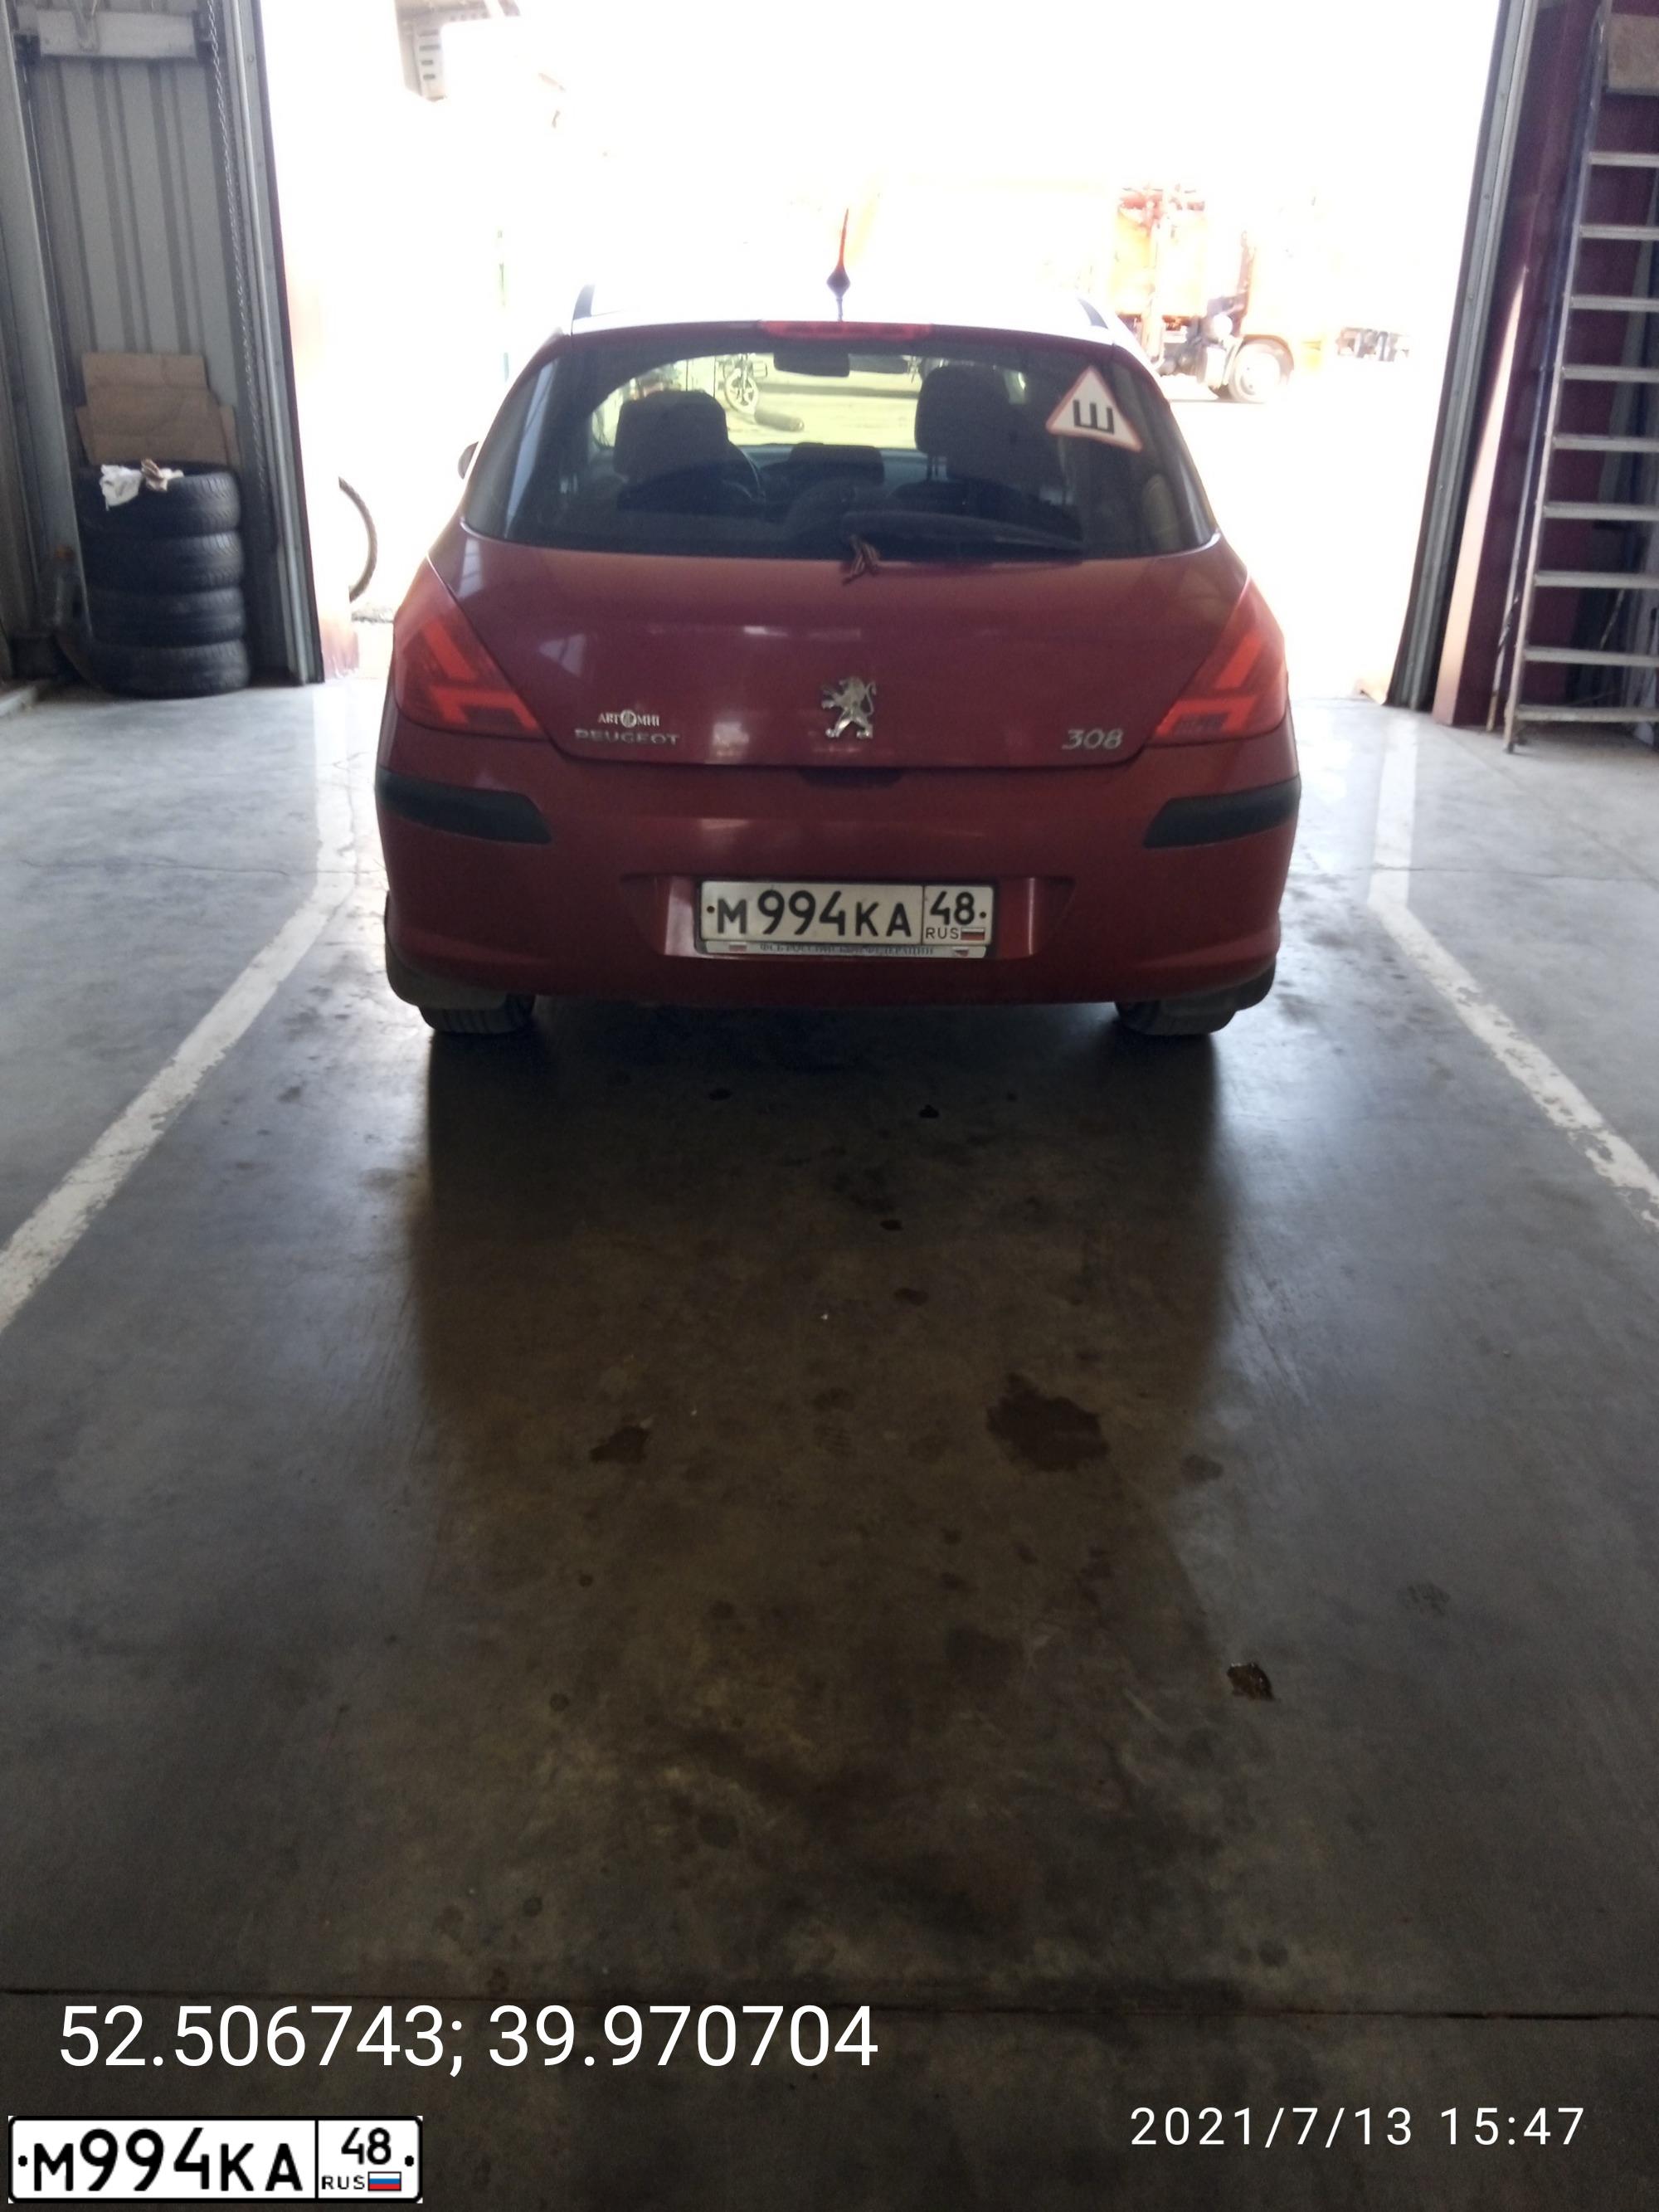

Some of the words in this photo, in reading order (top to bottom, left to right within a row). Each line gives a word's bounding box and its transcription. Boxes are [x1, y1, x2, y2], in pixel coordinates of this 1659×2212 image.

[575, 728, 679, 745] PEUGEOT
[1062, 728, 1124, 749] 308
[717, 889, 912, 938] М994КА
[930, 890, 975, 926] 48
[925, 927, 960, 940] RUS
